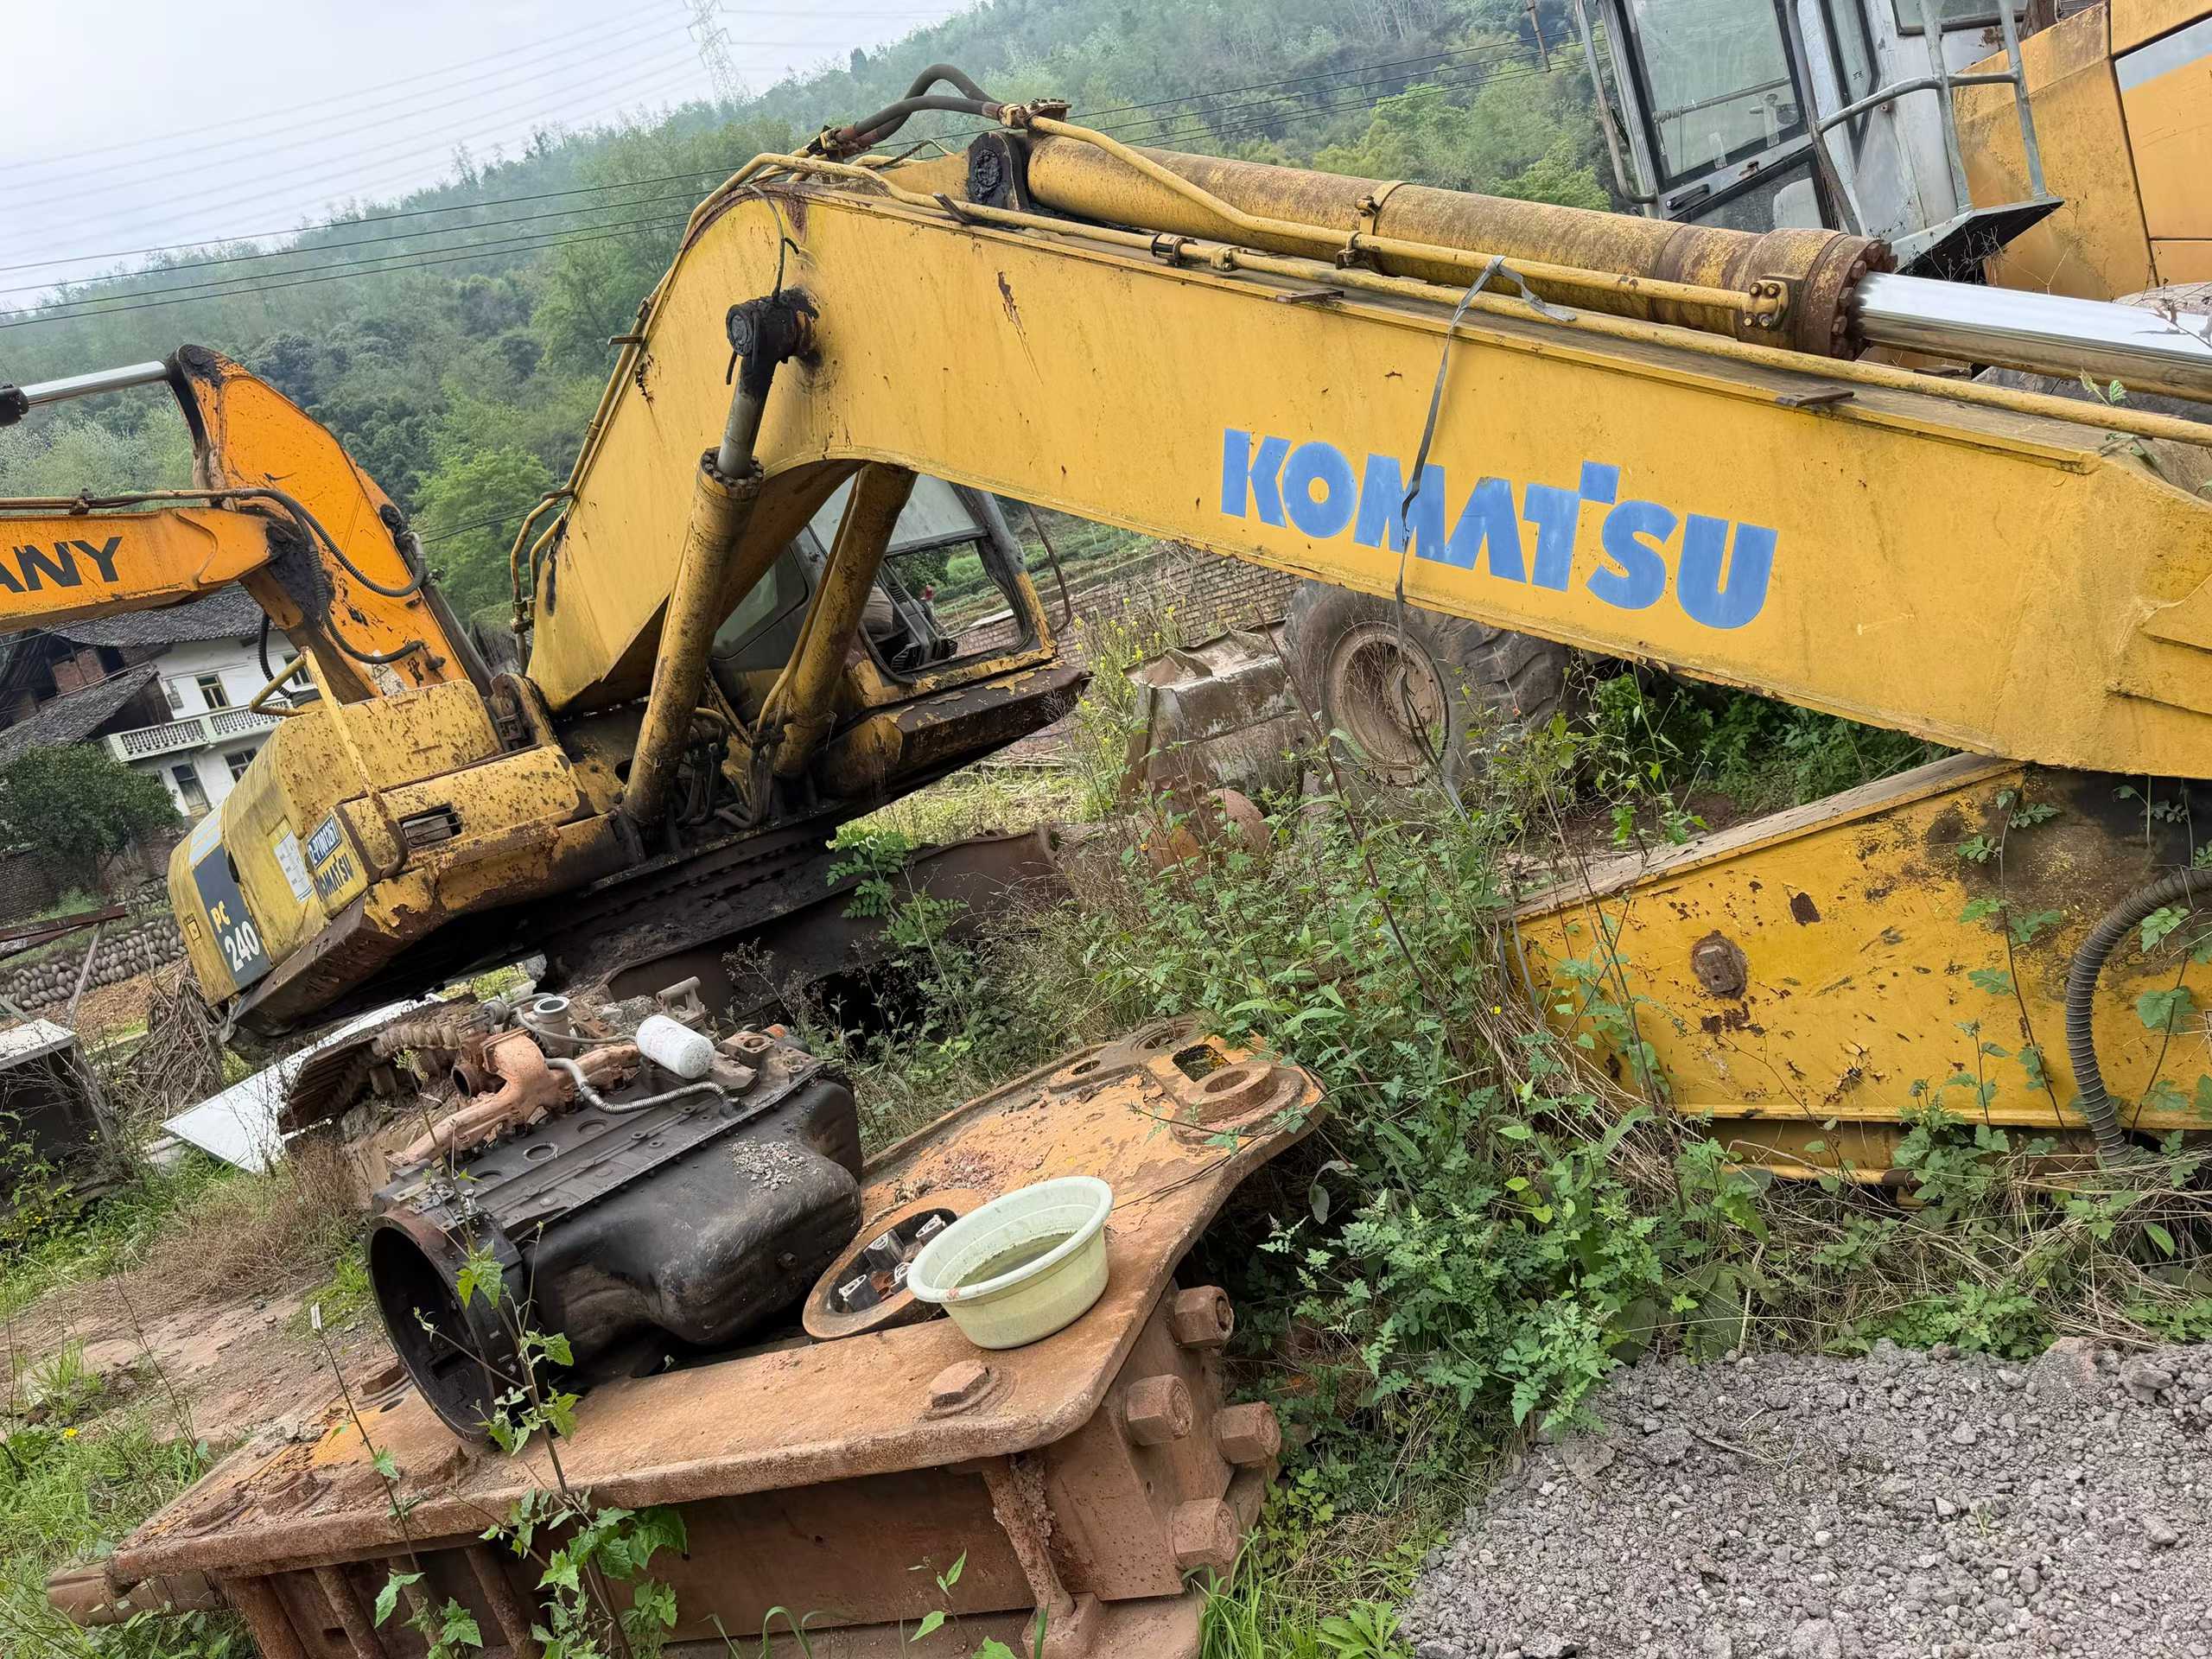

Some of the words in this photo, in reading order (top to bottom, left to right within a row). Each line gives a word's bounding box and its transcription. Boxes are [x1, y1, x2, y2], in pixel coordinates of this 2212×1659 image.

[1221, 428, 1779, 629] KOMATSU
[312, 854, 354, 902] KOMATSU
[210, 900, 231, 933] PC
[224, 920, 260, 972] 240
